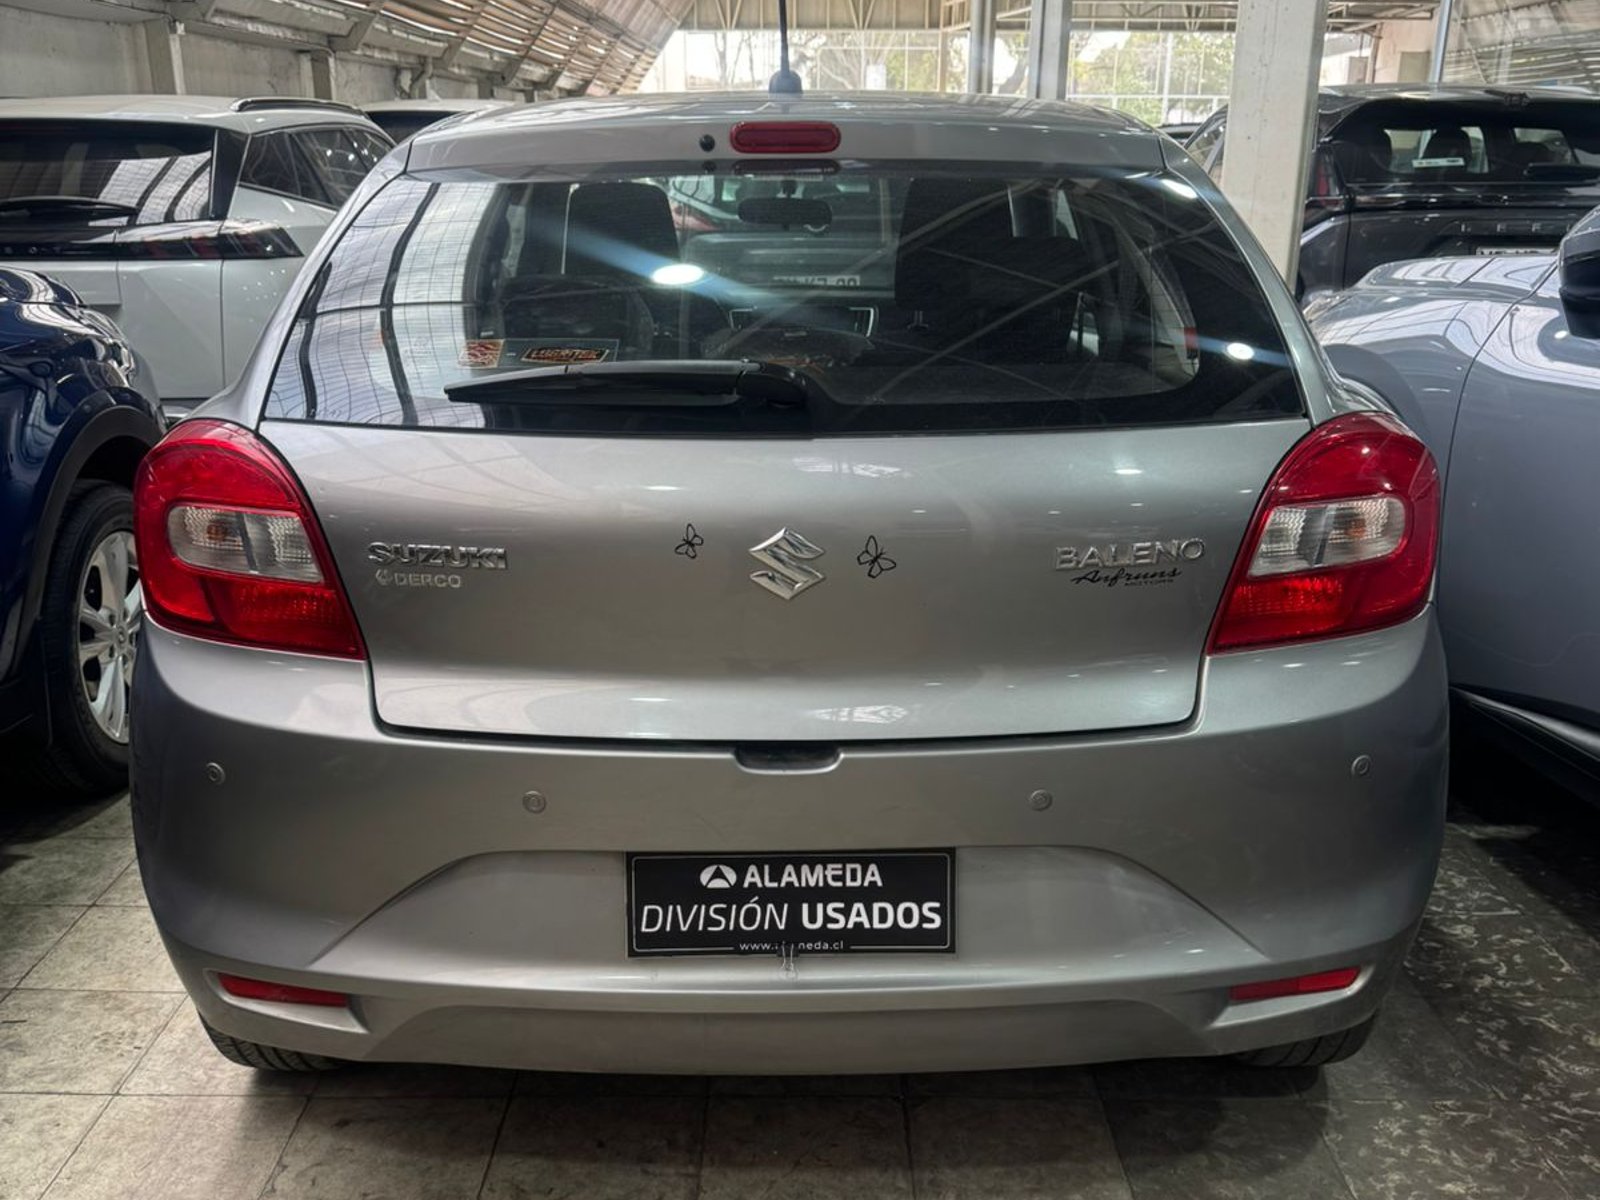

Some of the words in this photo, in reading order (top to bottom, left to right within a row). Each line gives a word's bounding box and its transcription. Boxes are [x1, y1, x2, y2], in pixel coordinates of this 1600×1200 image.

[368, 541, 507, 569] SUZUKI
[1055, 538, 1205, 571] BALENO
[394, 573, 462, 588] DERCO
[743, 863, 883, 888] ALAMEDA
[640, 896, 788, 932] DIVISIÓN
[802, 901, 942, 930] USADOS
